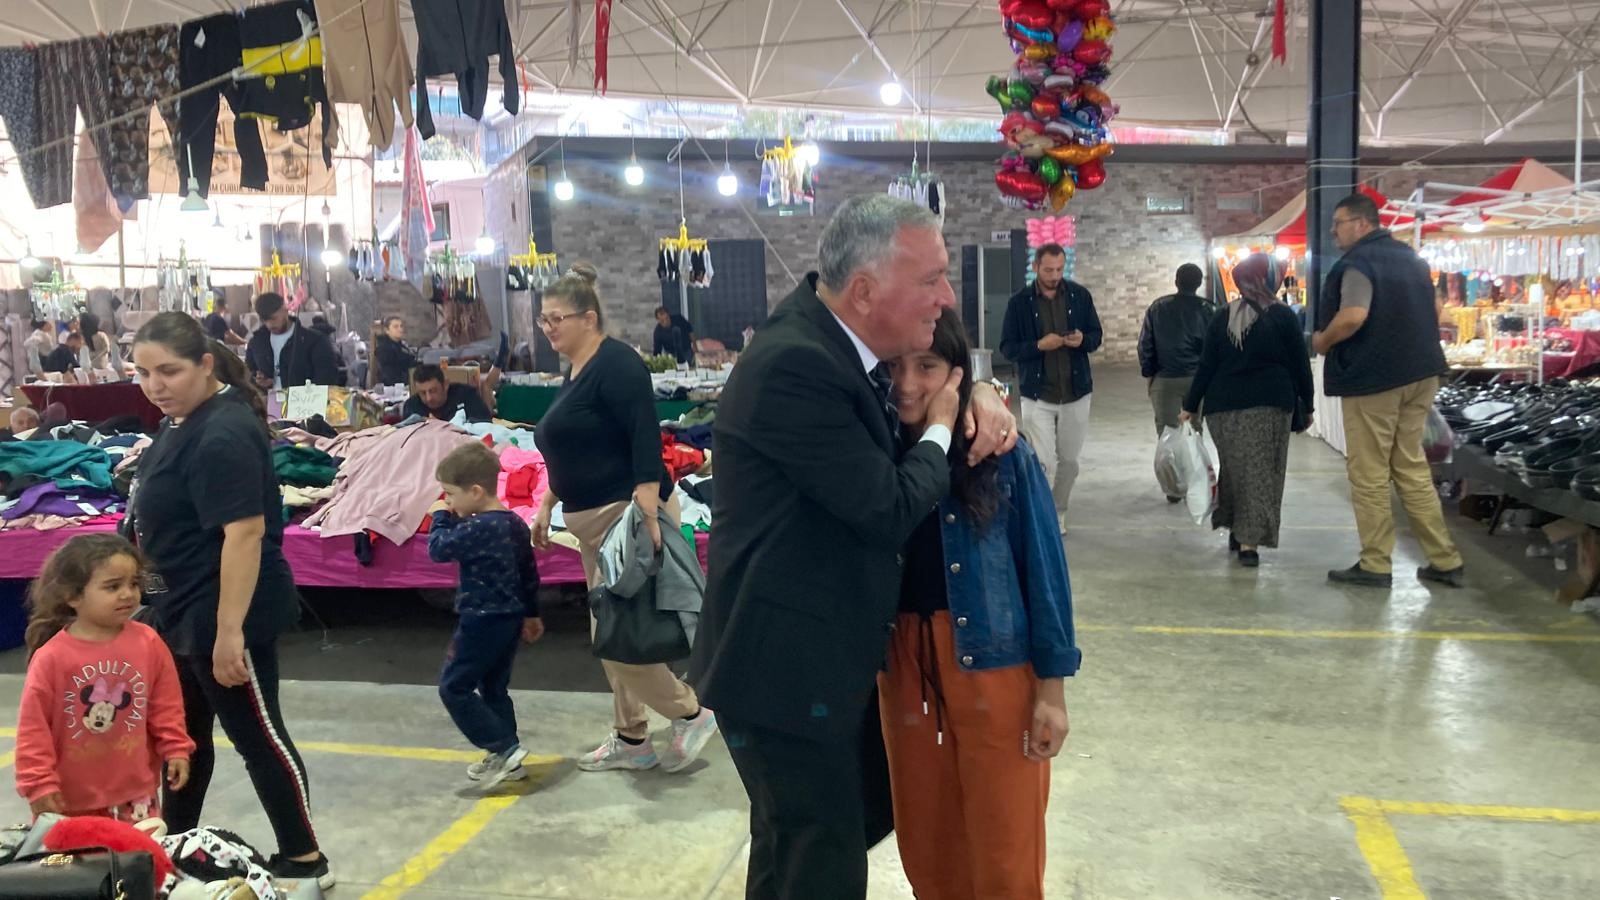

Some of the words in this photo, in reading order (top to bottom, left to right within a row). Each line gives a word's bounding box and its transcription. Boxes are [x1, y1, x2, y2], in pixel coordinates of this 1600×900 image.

[72, 659, 132, 689] ADULT
[63, 690, 77, 729] CAN
[123, 670, 147, 732] TODAY
[71, 729, 83, 740] I
